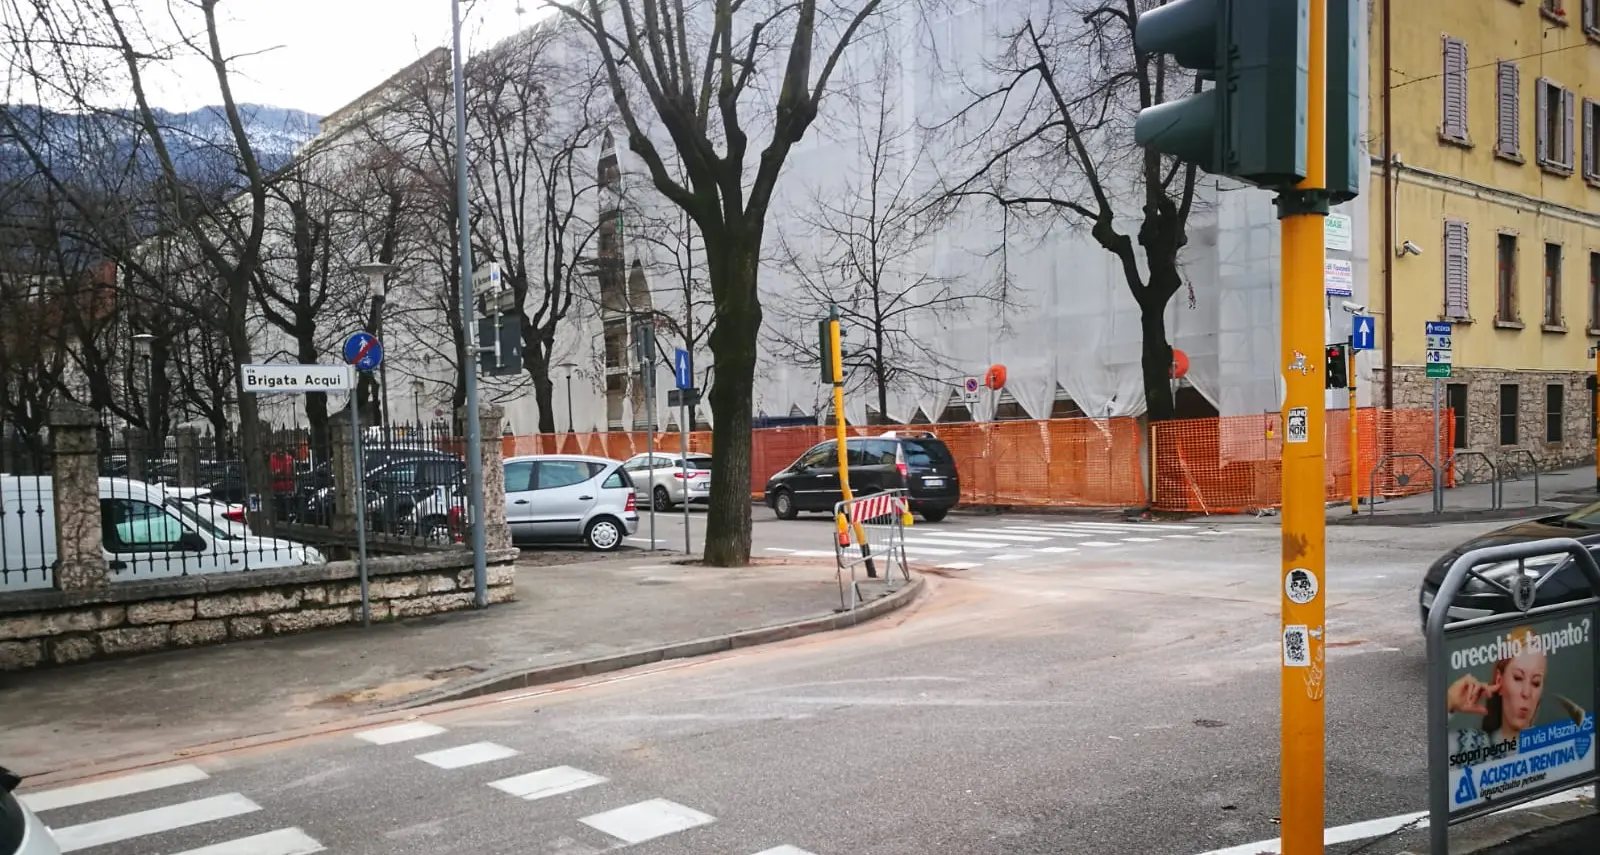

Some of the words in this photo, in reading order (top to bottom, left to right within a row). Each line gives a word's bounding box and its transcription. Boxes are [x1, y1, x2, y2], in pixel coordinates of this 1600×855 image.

[247, 374, 297, 387] Brigata
[304, 374, 341, 386] Acqui
[1451, 634, 1522, 670] orecchio
[1525, 618, 1590, 656] tappato?
[1449, 750, 1481, 767] scopri
[1482, 736, 1517, 760] perché
[1521, 734, 1531, 748] in
[1532, 731, 1546, 745] via
[1480, 760, 1528, 787] ACUSTICA
[1528, 746, 1576, 773] TRENTINA
